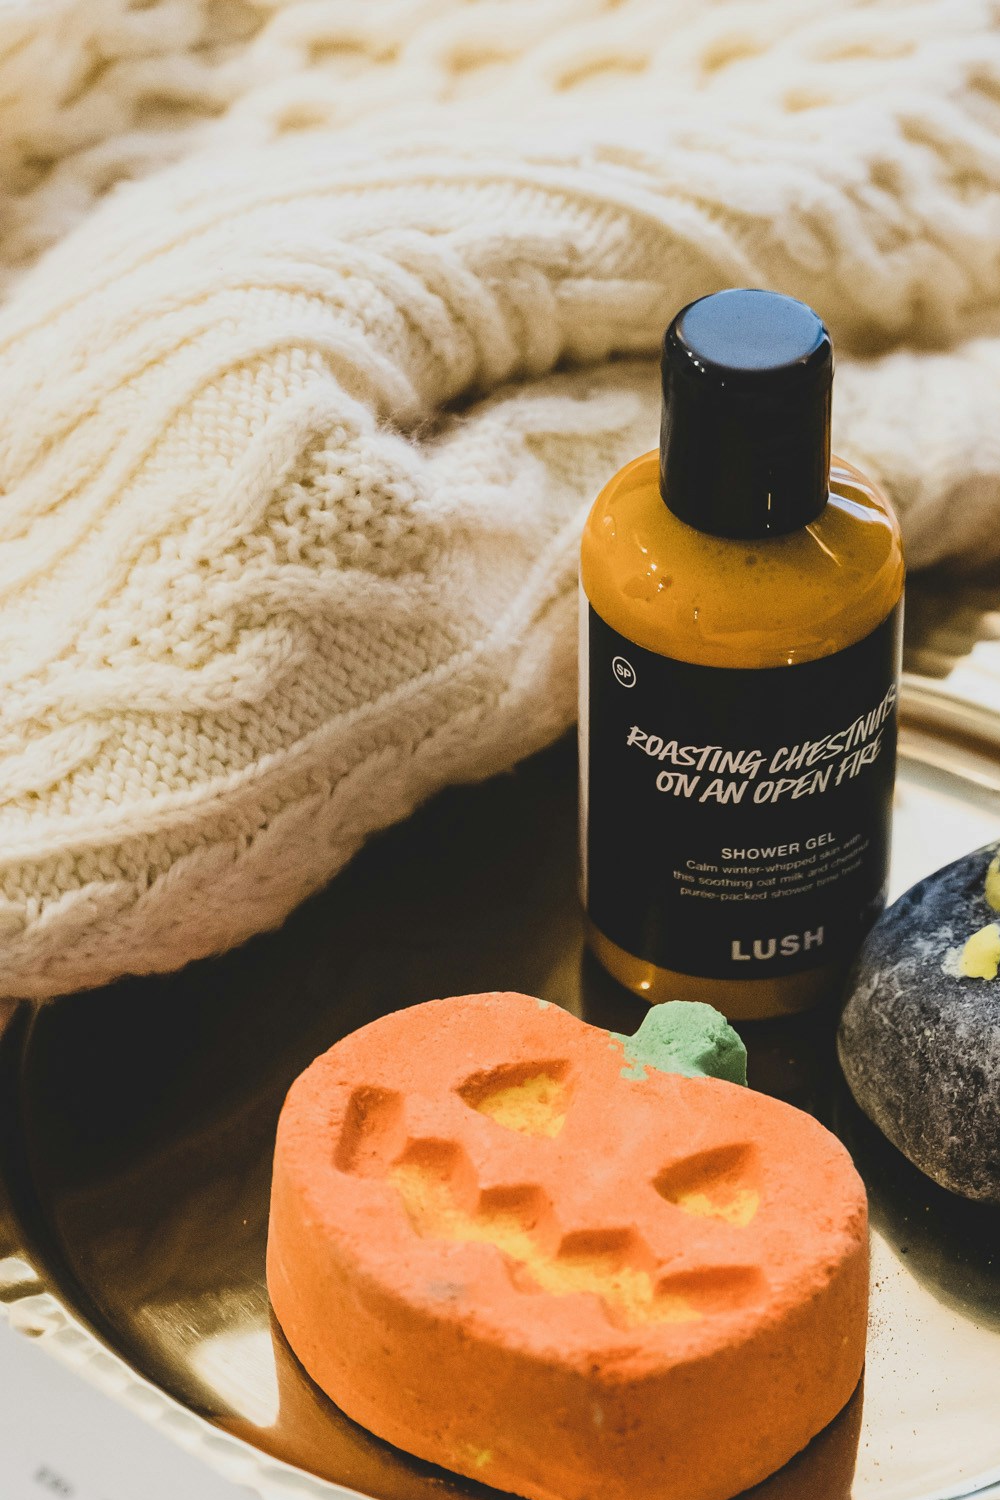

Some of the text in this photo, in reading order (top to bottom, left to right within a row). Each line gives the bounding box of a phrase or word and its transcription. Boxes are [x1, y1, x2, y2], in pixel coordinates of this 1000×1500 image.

[616, 663, 632, 679] SP
[627, 684, 896, 779] ROASTING CHESTNUTS
[656, 728, 884, 804] ON AN OPEN FIRE
[721, 832, 836, 860] SHOWER GEL
[686, 860, 718, 872] Calm
[722, 855, 817, 875] winter-whipped
[673, 871, 695, 883] this
[698, 878, 753, 889] soothing
[756, 878, 776, 887] oat
[780, 872, 803, 883] milk
[771, 884, 814, 898] shower
[732, 926, 823, 961] LUSH
